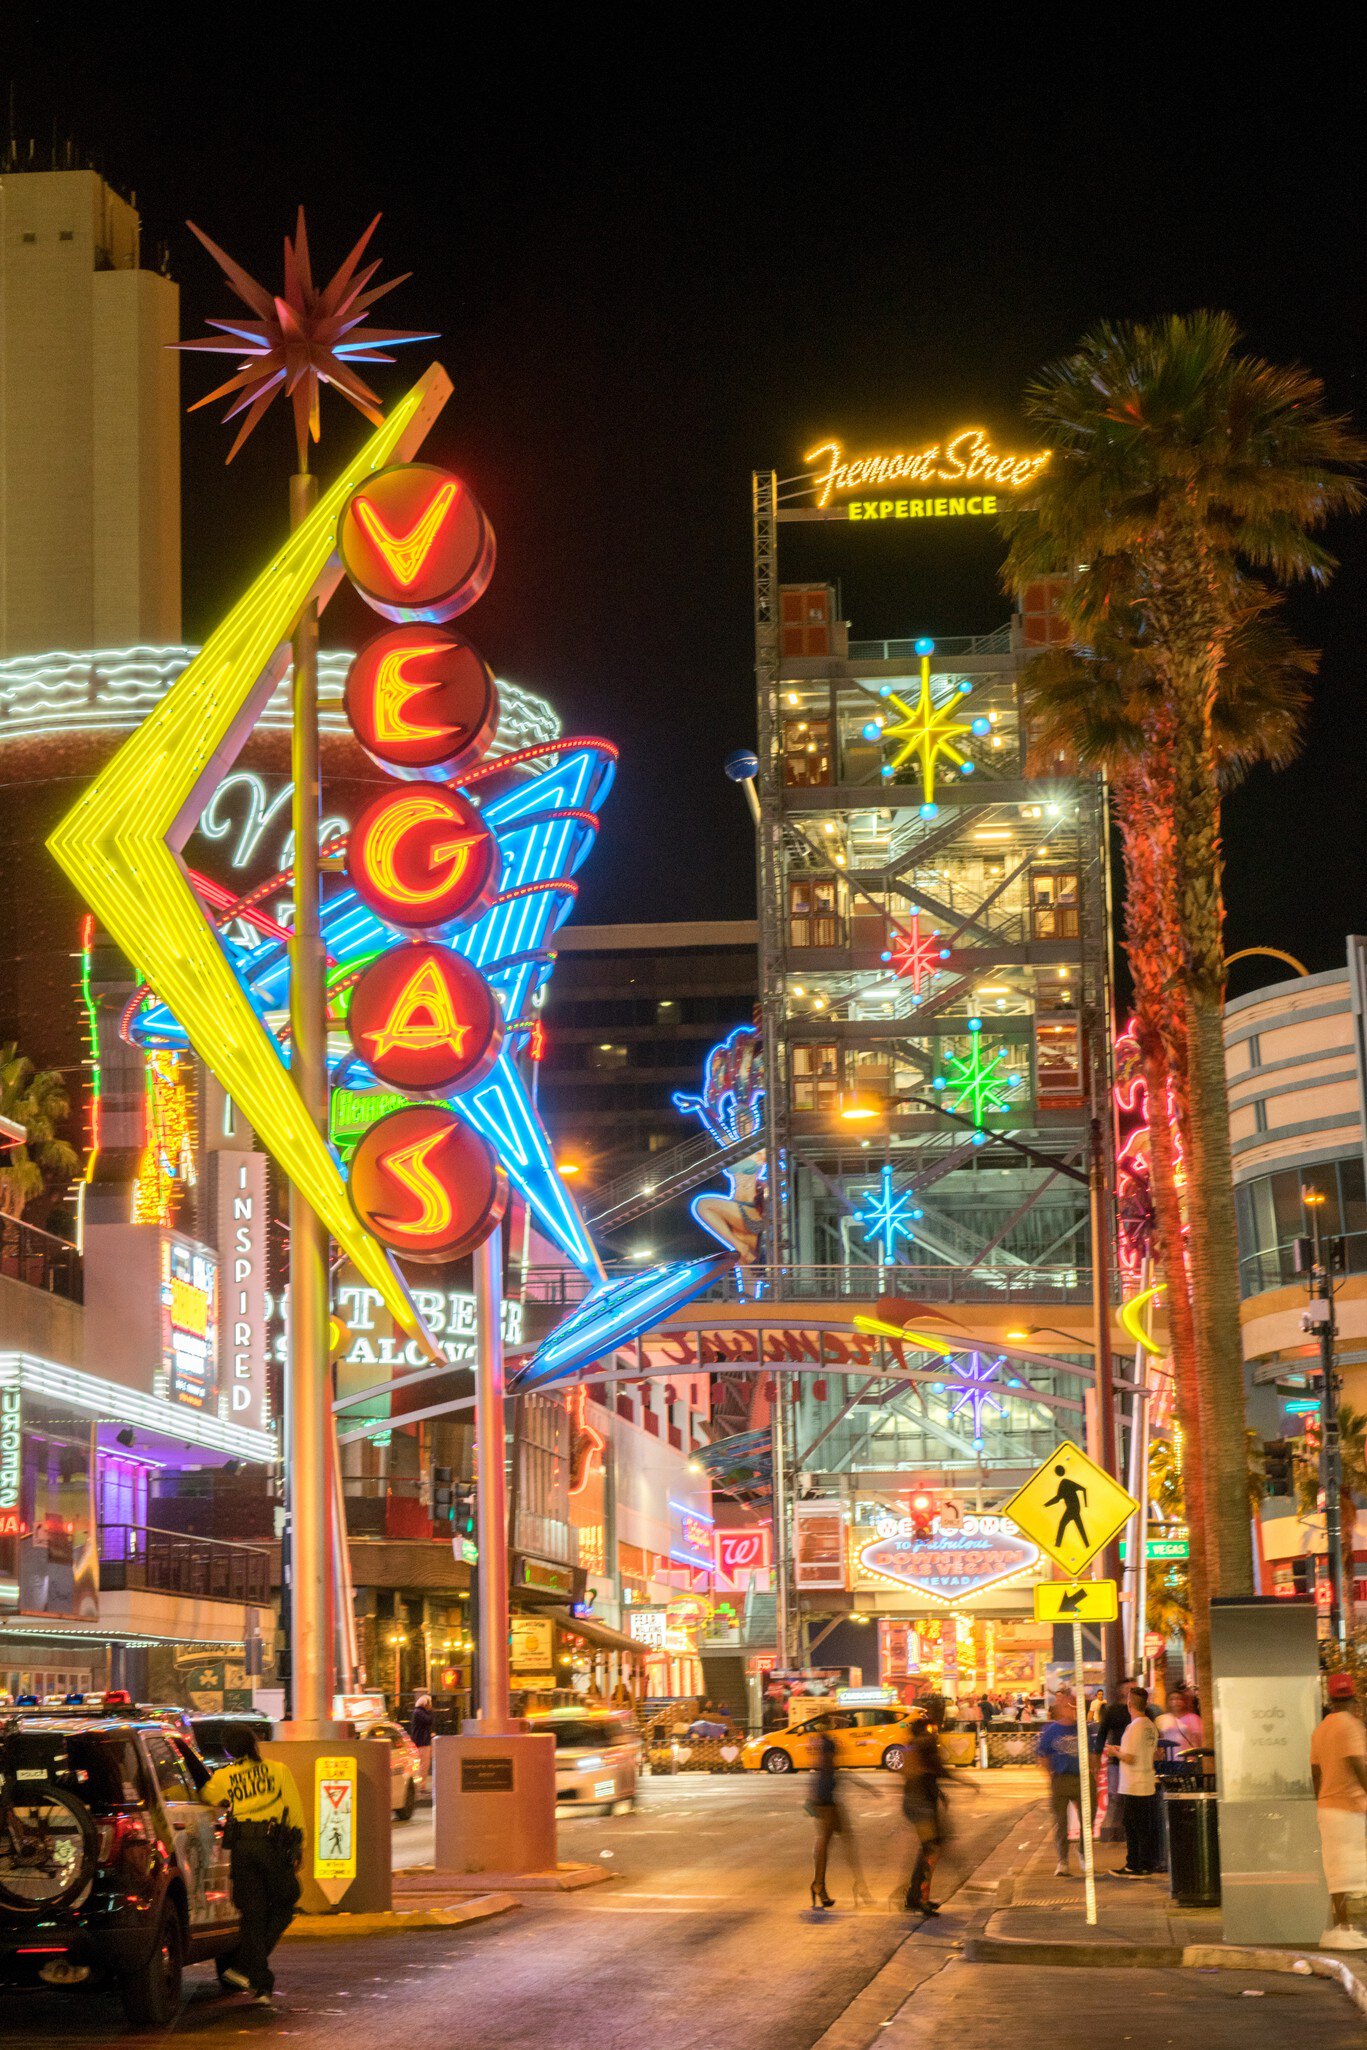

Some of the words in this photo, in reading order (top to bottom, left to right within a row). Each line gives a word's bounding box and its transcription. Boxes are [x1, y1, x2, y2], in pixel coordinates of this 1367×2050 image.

[805, 441, 941, 508] Fremont
[848, 496, 997, 520] EXPERIENCE
[351, 478, 491, 1236] VEGAS
[232, 1165, 252, 1411] INSPIRED
[409, 1289, 523, 1345] BER
[877, 1515, 1021, 1539] WEOME
[721, 1535, 760, 1566] W
[875, 1550, 1024, 1565] DOWNTOWN
[1153, 1543, 1186, 1556] VEGAS
[893, 1564, 936, 1577] LAS
[939, 1563, 1007, 1576] VEGAS
[918, 1576, 981, 1587] NEVADA
[229, 1763, 270, 1786] METRO
[227, 1776, 275, 1802] POLICE
